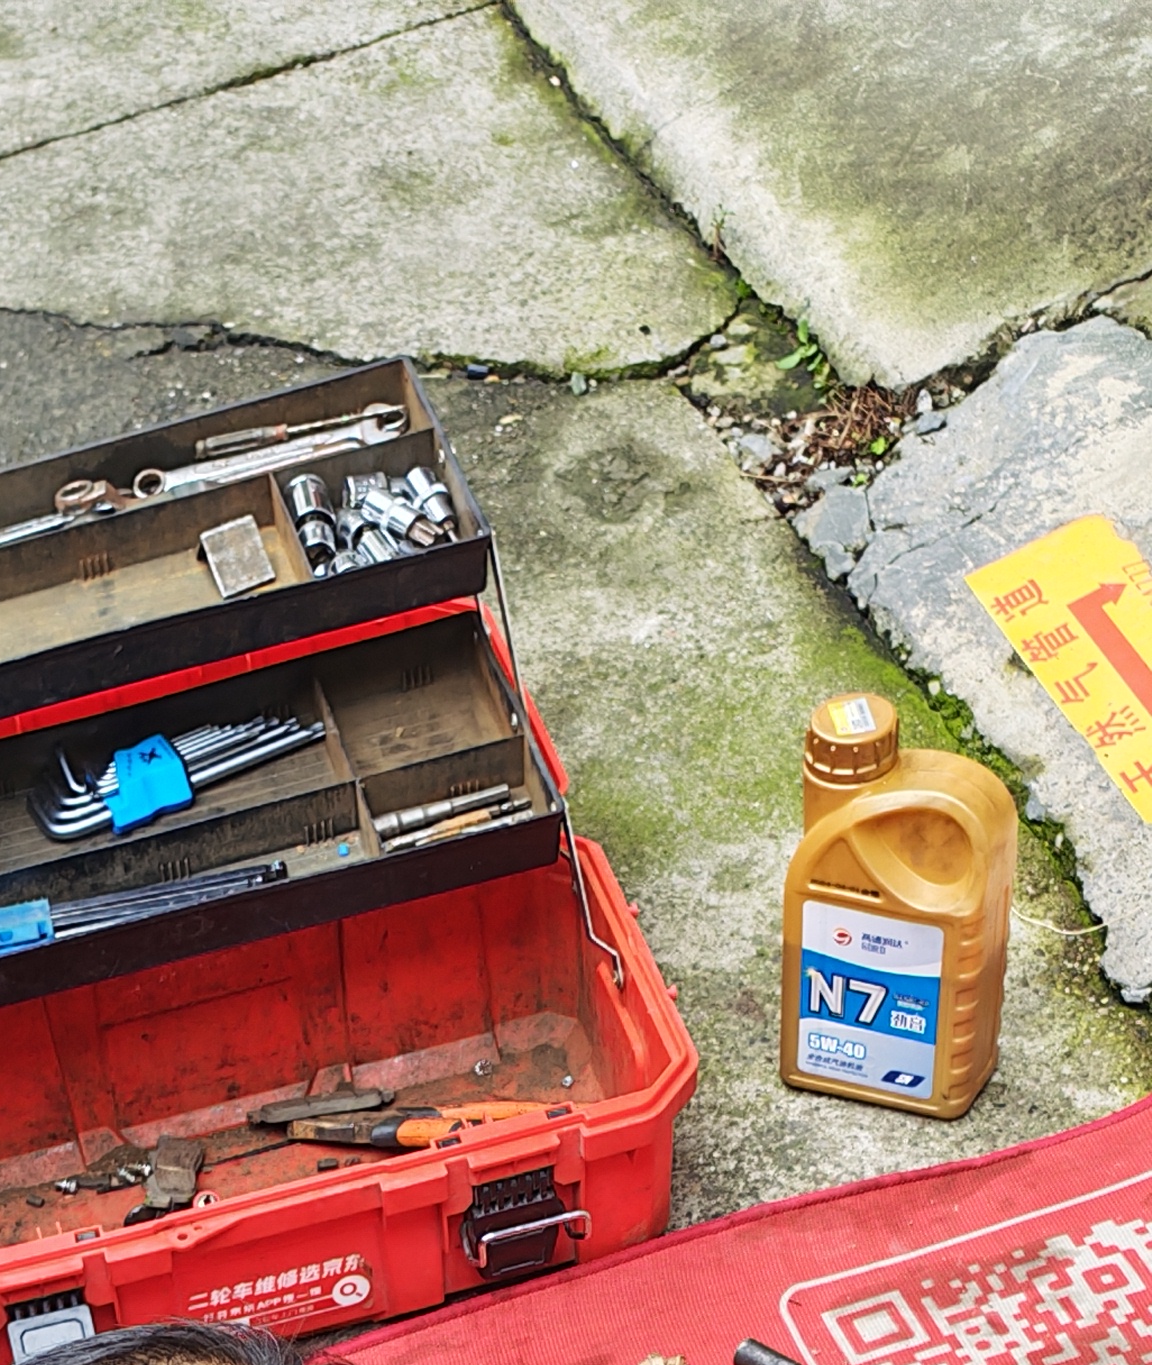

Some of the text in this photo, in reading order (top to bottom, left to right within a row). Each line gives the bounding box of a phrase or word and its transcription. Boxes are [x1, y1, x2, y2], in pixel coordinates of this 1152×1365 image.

[808, 968, 888, 1025] N7
[807, 1032, 866, 1061] 5W-40
[187, 1253, 365, 1312] 二轮车维修选京东
